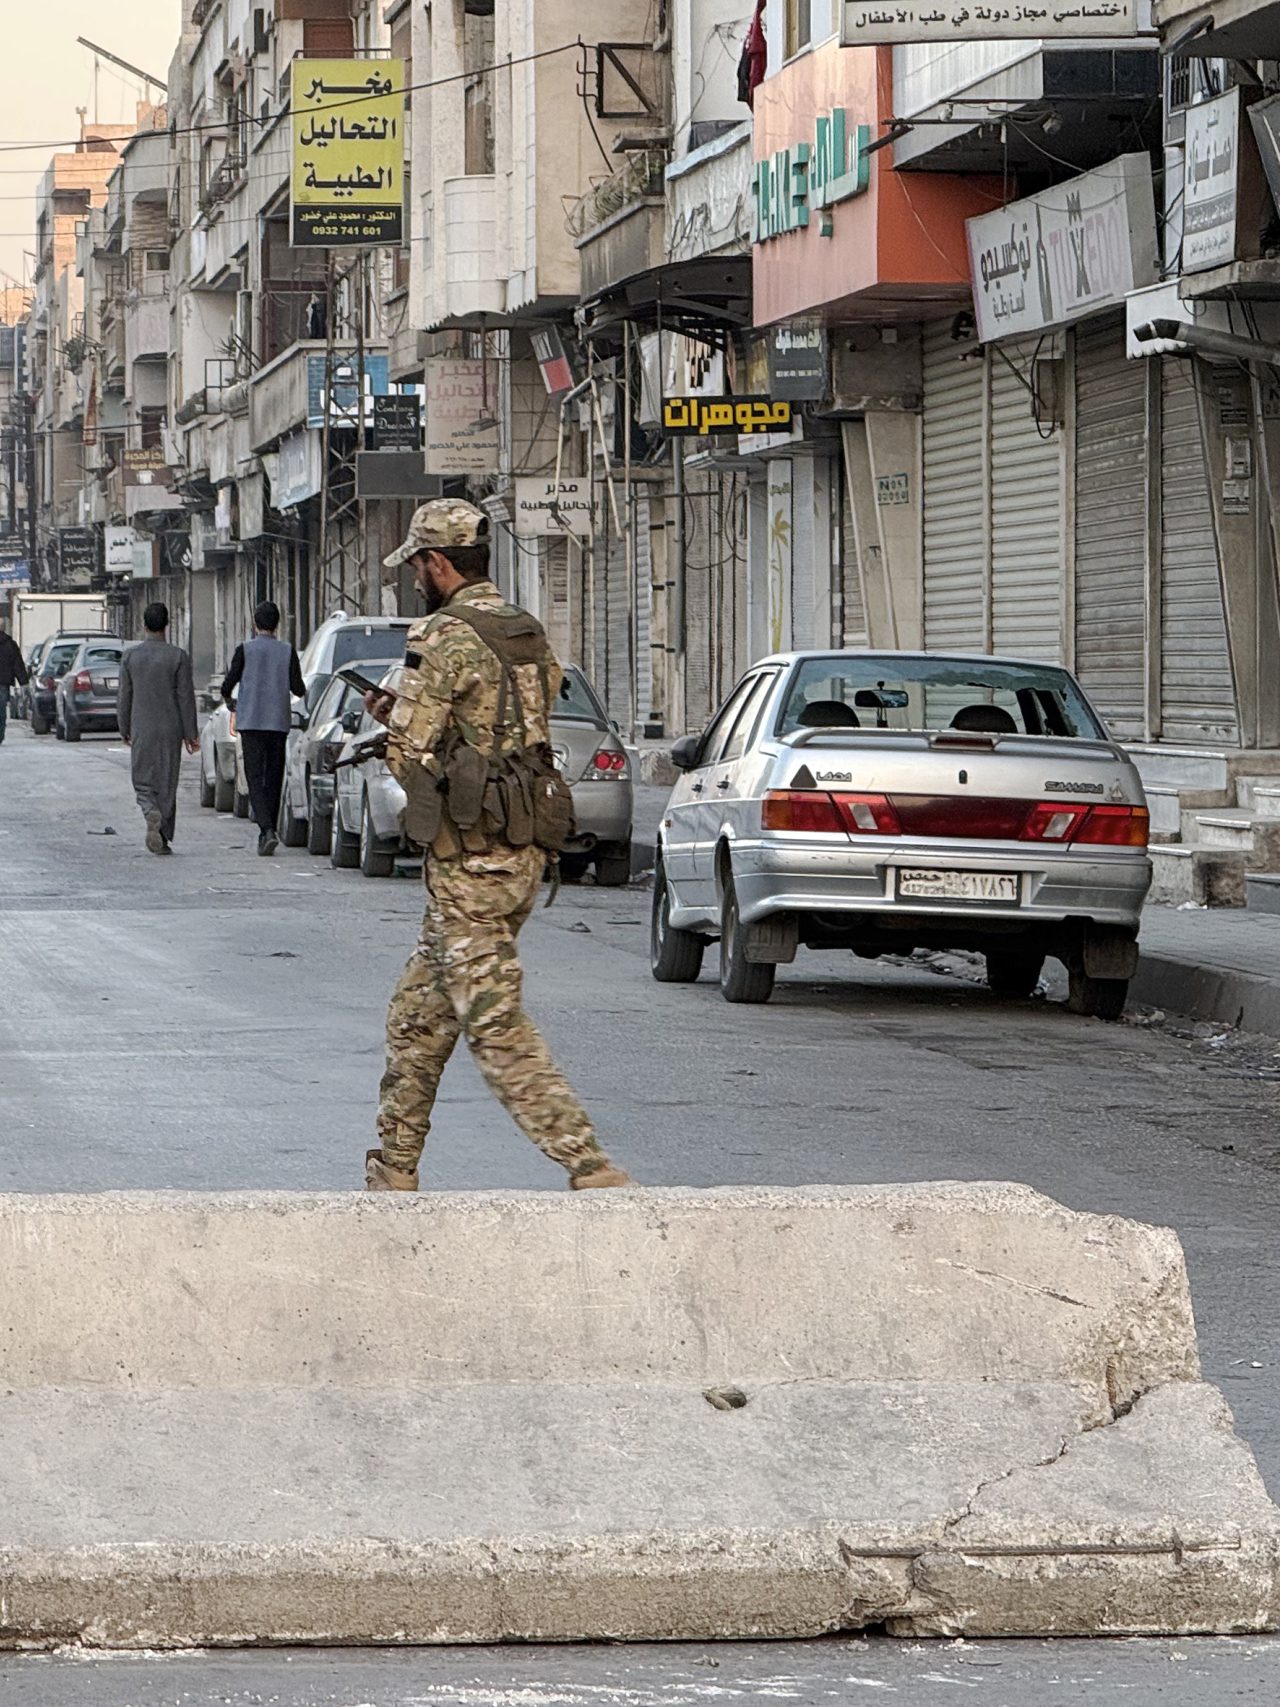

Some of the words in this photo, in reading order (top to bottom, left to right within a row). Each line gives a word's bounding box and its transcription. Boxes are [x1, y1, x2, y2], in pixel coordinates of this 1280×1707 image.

[855, 8, 913, 28] الأطفال
[919, 10, 946, 26] طب
[951, 7, 969, 26] في
[975, 5, 1010, 21] دولة
[1016, 5, 1047, 21] مجاز
[1053, 4, 1128, 23] اختصاصي
[303, 71, 393, 103] مخبر
[300, 116, 396, 147] التحاليل
[302, 162, 393, 196] الطبية
[312, 226, 338, 235] 0932
[341, 226, 359, 235] 741
[363, 226, 381, 235] 601
[664, 399, 791, 435] مجوهرات
[1043, 780, 1104, 795] SAMARA
